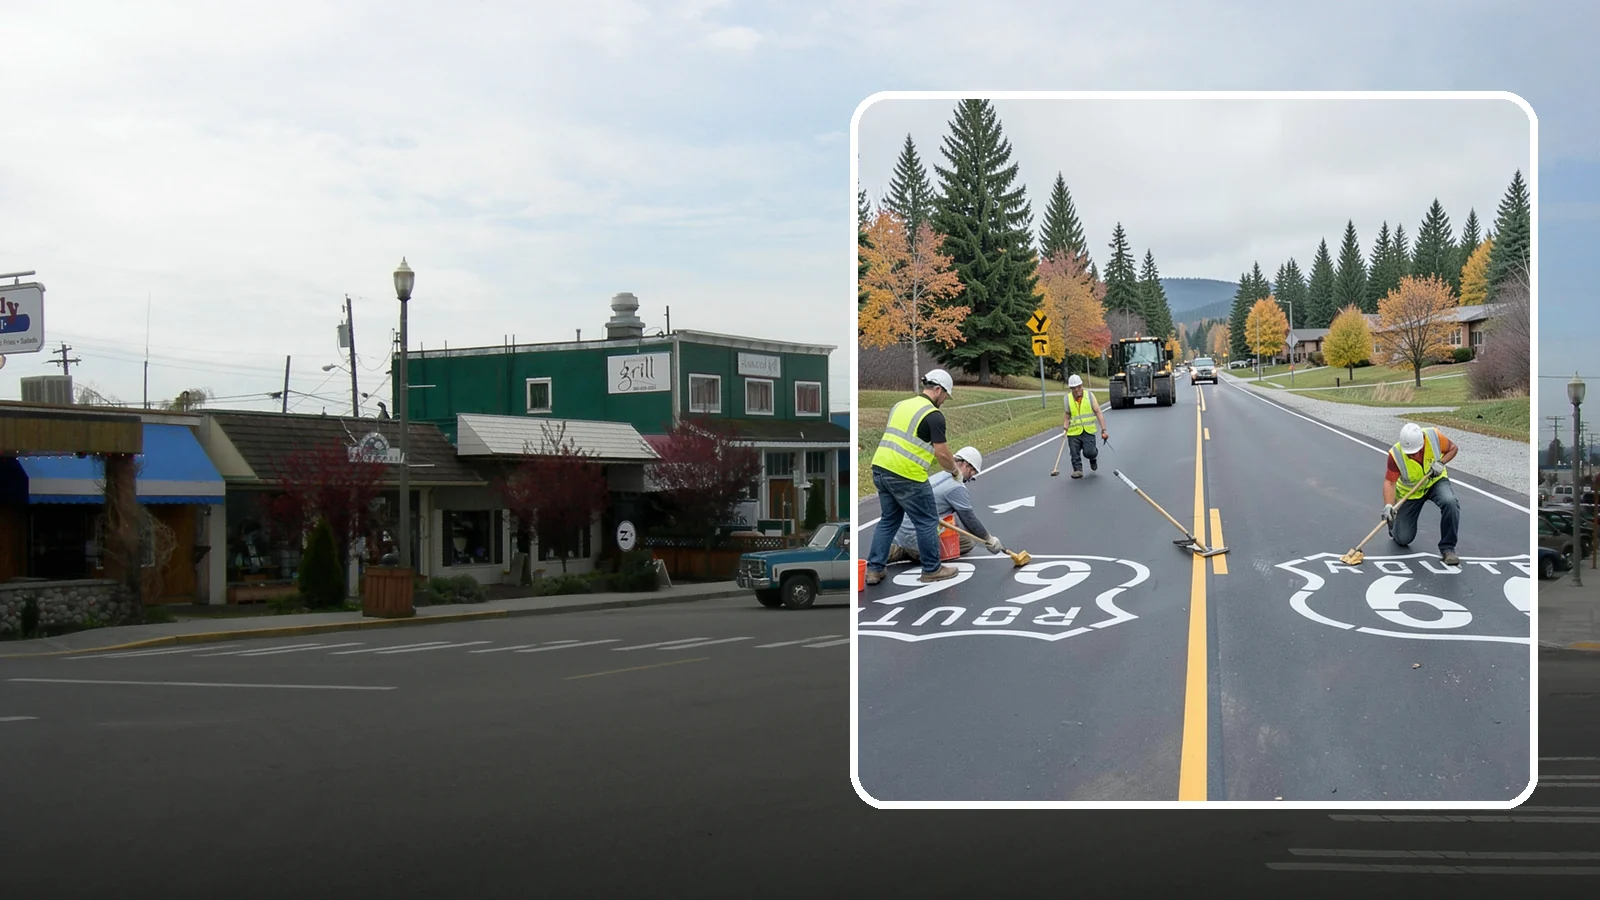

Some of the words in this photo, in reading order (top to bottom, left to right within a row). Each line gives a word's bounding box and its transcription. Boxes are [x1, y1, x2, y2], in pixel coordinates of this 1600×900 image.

[617, 356, 655, 392] grill
[858, 606, 1082, 627] ROUT
[1365, 575, 1530, 629] 6
